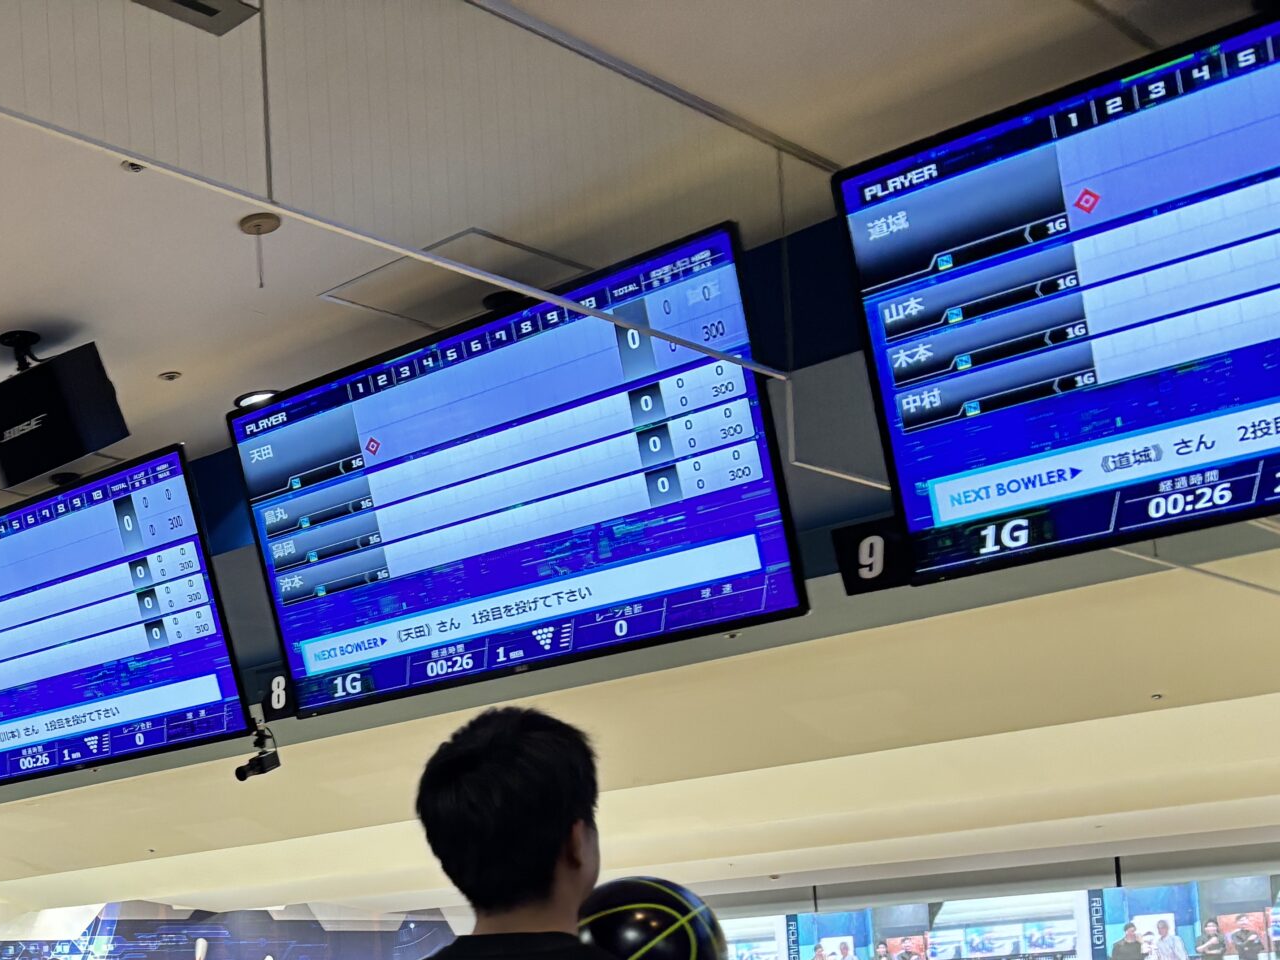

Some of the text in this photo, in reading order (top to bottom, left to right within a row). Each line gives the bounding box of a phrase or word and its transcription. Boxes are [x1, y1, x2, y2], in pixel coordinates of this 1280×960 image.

[864, 49, 1257, 201] PLAYER 1 2 3 4 5
[1046, 218, 1067, 235] 1G
[1057, 275, 1077, 291] 1G
[663, 285, 711, 315] 0 0
[884, 297, 925, 324] 山本
[627, 328, 640, 350] 0
[701, 320, 726, 342] 300
[1065, 324, 1086, 340] 1G
[245, 412, 288, 435] PLAYER
[357, 382, 365, 393] 1
[377, 374, 388, 386] 2
[400, 366, 411, 377] 3
[423, 357, 434, 368] 4
[446, 348, 458, 360] 5
[470, 340, 482, 351] 6
[495, 330, 507, 342] 7
[520, 320, 532, 333] 8
[546, 311, 559, 323] 9
[612, 282, 639, 298] TOTAL
[892, 344, 934, 369] 木本
[640, 395, 653, 412] 0
[676, 378, 685, 389] 0
[715, 365, 724, 376] 0
[1074, 372, 1096, 387] 1G
[680, 381, 735, 407] 0 300
[902, 388, 942, 414] 中村
[648, 436, 662, 453] 0
[685, 419, 693, 430] 0
[723, 407, 732, 419] 0
[688, 424, 743, 448] 0 300
[250, 445, 274, 463] 天田
[657, 477, 670, 493] 0
[693, 461, 701, 472] 0
[732, 449, 741, 460] 0
[697, 466, 751, 489] 0 300
[949, 484, 991, 508] NEXT
[996, 468, 1067, 498] BOWLER
[1173, 434, 1216, 456] さん
[1147, 482, 1233, 519] 00:26
[124, 515, 133, 531] 0
[979, 518, 1030, 554] 1G
[136, 565, 145, 578] 0
[858, 535, 885, 580] 9
[144, 596, 153, 609] 0
[152, 627, 161, 640] 0
[313, 647, 337, 662] NEXT
[339, 638, 379, 657] BOWLER
[437, 618, 461, 633] さん
[471, 586, 592, 625] 1投目を投げて下さい
[333, 673, 362, 698] 1G
[426, 654, 474, 678] 00:26
[496, 646, 507, 662] 1
[614, 620, 628, 637] 0
[271, 675, 286, 710] 8
[19, 753, 50, 770] 00:26
[135, 732, 145, 745] 0
